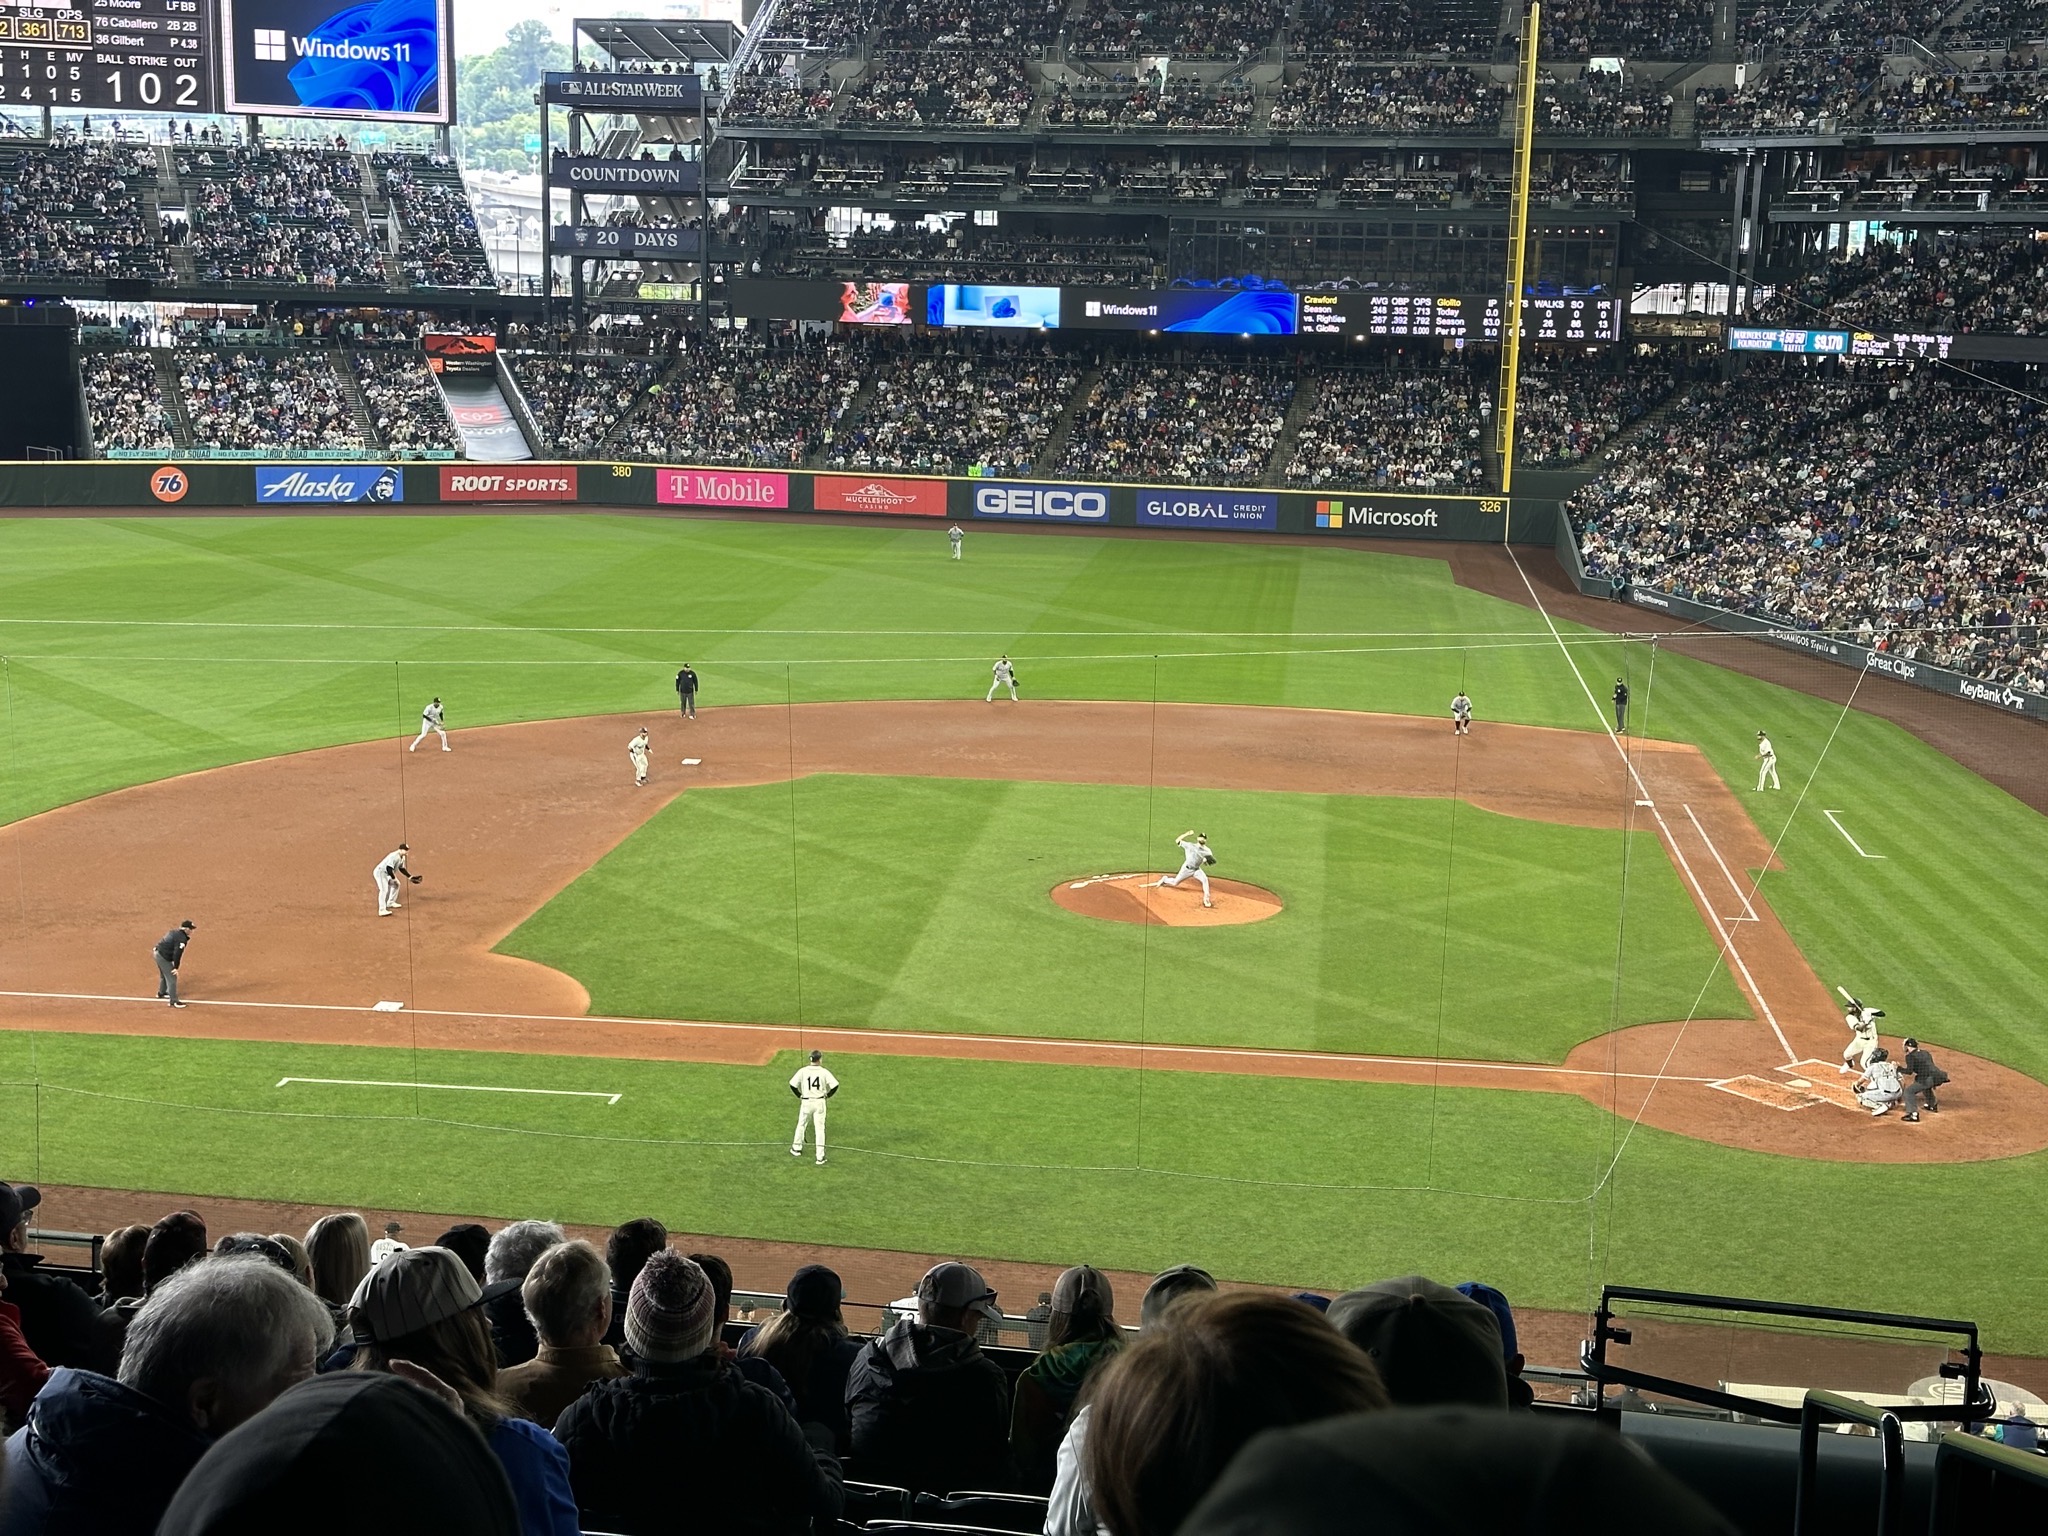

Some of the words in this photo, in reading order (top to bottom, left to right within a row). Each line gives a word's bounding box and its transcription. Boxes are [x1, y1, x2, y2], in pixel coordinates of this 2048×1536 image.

[109, 0, 141, 9] Moore
[166, 1, 179, 10] LF
[181, 2, 196, 11] BB
[19, 8, 44, 18] SLG
[57, 10, 83, 20] OPS
[18, 23, 47, 37] .361
[57, 25, 85, 38] .713
[95, 17, 108, 26] 76
[110, 17, 158, 29] Caballero
[166, 20, 180, 31] 2B
[182, 21, 197, 31] 2B
[96, 34, 109, 44] 36
[110, 35, 144, 47] Gilbert
[170, 38, 178, 47] P
[181, 39, 197, 49] 4.38
[20, 50, 29, 60] H
[47, 51, 55, 61] E
[66, 52, 83, 62] MV
[292, 36, 390, 61] Windows
[393, 43, 410, 62] 11
[96, 54, 124, 64] BALL
[128, 55, 168, 67] STRIKE
[173, 58, 198, 68] OUT
[22, 64, 29, 78] 1
[46, 65, 57, 79] 0
[69, 66, 80, 80] 5
[20, 86, 32, 100] 4
[49, 87, 57, 101] 1
[70, 88, 81, 102] 5
[106, 71, 121, 102] 1
[139, 72, 161, 104] 0
[175, 74, 198, 106] 2
[644, 83, 683, 97] WEEK
[570, 166, 680, 183] COUNTDOWN
[597, 231, 619, 245] 20
[634, 233, 678, 246] DAYS
[1304, 295, 1338, 304] Crawford
[1370, 297, 1388, 305] AVG
[1391, 297, 1410, 306] OBP
[1413, 297, 1432, 306] OPS
[1488, 299, 1497, 307] IP
[1534, 300, 1565, 309] WALKS
[1570, 300, 1584, 309] SO
[1597, 301, 1611, 309] HR
[1102, 304, 1148, 316] Windows
[1148, 305, 1158, 316] 11
[1303, 305, 1332, 313] Season
[1436, 308, 1459, 317] Today
[1485, 308, 1499, 317] 0.0
[1545, 310, 1552, 318] 0
[1573, 310, 1580, 318] 0
[1600, 311, 1607, 319] 0
[1316, 314, 1346, 324] Righties
[1436, 317, 1465, 325] Season
[1598, 320, 1608, 328] 13
[1435, 327, 1449, 335] Per
[1450, 327, 1456, 335] 9
[1457, 327, 1466, 336] IP
[1484, 328, 1498, 336] 9.0
[1594, 330, 1611, 339] 1.41
[1893, 333, 1910, 342] Balls
[1911, 334, 1935, 343] Strikes
[1936, 335, 1953, 344] Total
[1852, 340, 1869, 348] Pitch
[1870, 340, 1890, 349] Count
[1852, 347, 1867, 355] First
[1867, 347, 1884, 356] Pitch
[1939, 351, 1948, 359] 10
[285, 450, 308, 458] SQUAD
[612, 466, 632, 477] 380
[158, 475, 182, 494] 76
[263, 472, 356, 500] Alaska
[451, 476, 504, 492] ROOT
[505, 479, 568, 492] SPORTS
[696, 476, 775, 503] Mobile
[845, 495, 904, 505] MUCKLESHOOT
[976, 488, 1107, 517] GEICO
[1479, 501, 1501, 513] 326
[1147, 501, 1229, 518] GLOBAL
[1233, 504, 1266, 513] CREDIT
[1233, 512, 1263, 520] UNION
[1349, 506, 1438, 527] Microsoft
[1866, 652, 1893, 672] Great
[1893, 659, 1915, 679] Clips
[1959, 680, 2001, 704] KeyBank
[807, 1076, 820, 1091] 14
